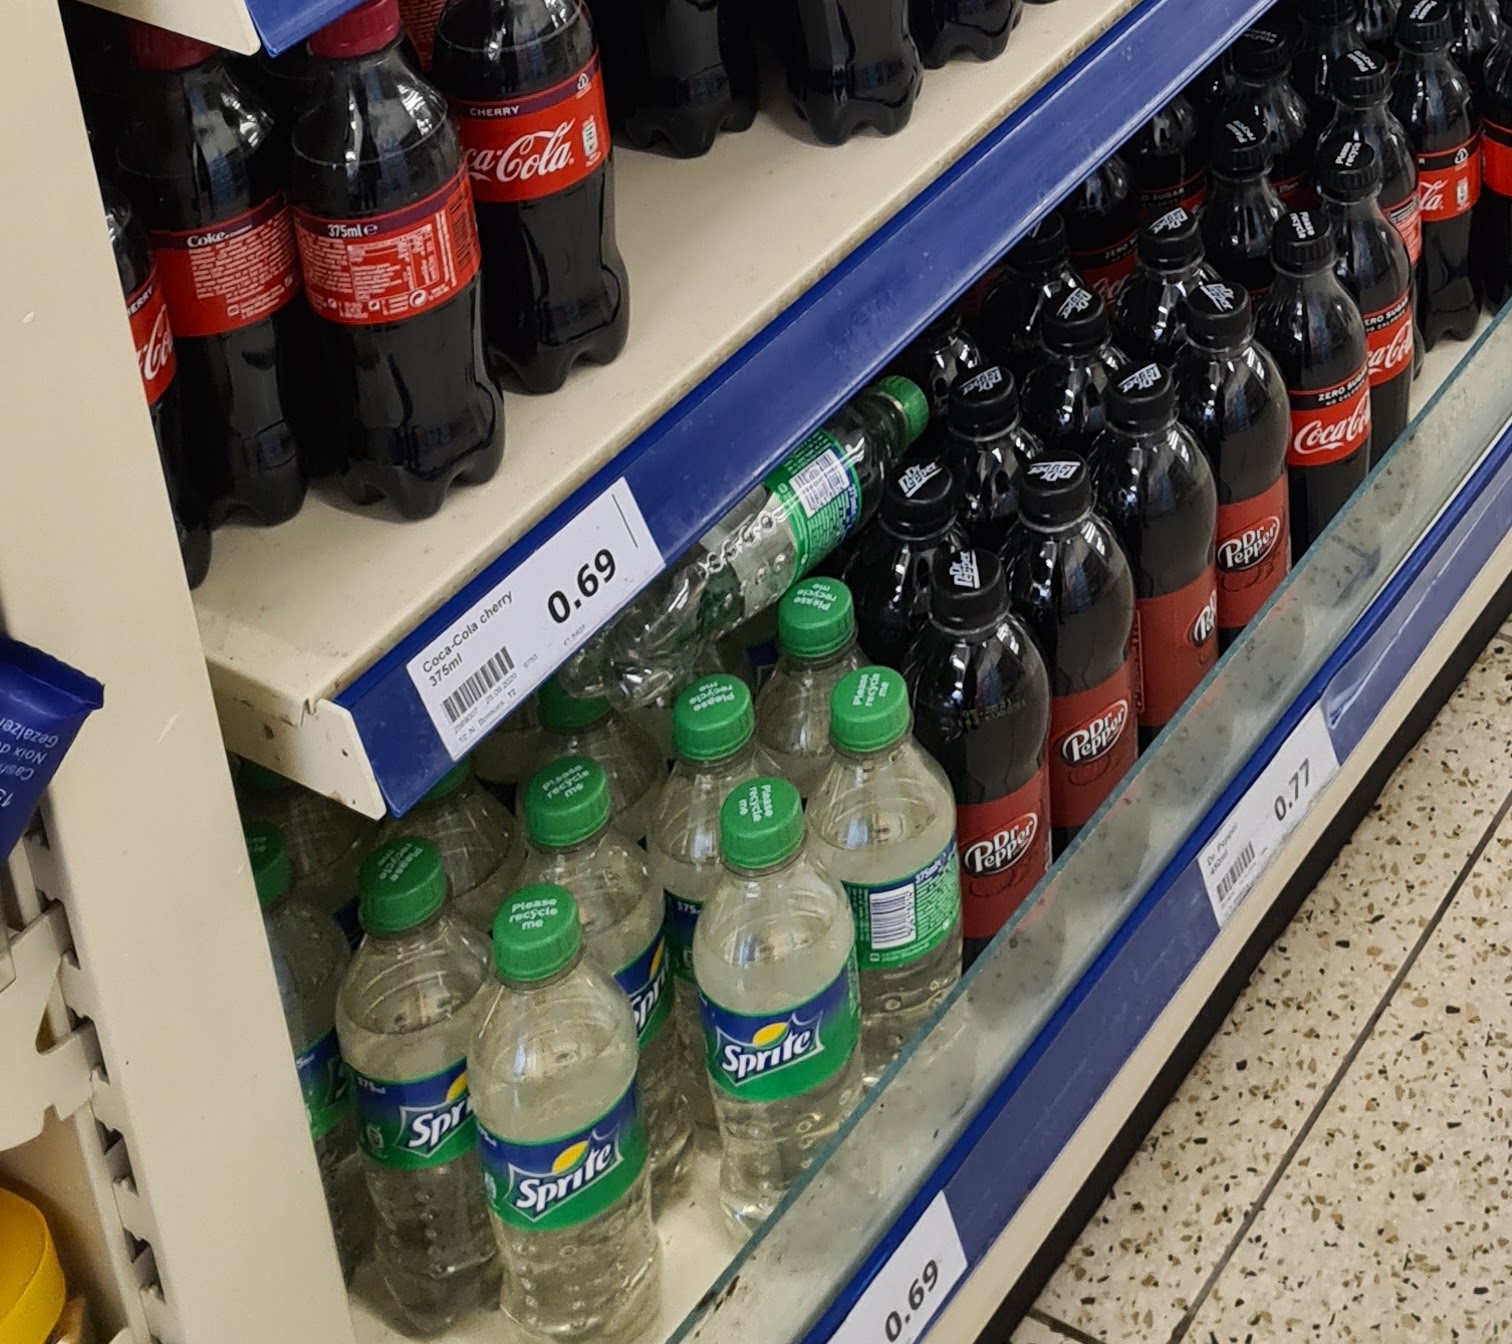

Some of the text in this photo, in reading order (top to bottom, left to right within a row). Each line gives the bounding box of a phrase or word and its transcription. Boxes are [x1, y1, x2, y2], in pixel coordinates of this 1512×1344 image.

[469, 104, 520, 119] CHERRY
[327, 223, 363, 239] 375ml
[1317, 387, 1341, 402] ZERO
[1220, 523, 1277, 569] Pepper
[1240, 526, 1265, 546] Dr
[547, 548, 616, 625] 0.69
[422, 590, 514, 675] Coca-Cola cherry
[427, 652, 464, 688] 375ml
[852, 674, 869, 706] Please
[1065, 707, 1124, 762] Pepper
[1089, 713, 1113, 733] Dr
[18, 747, 47, 766] Noix
[541, 764, 583, 792] Please
[545, 769, 591, 800] recycle
[564, 782, 585, 798] me
[1273, 757, 1311, 822] 0.77
[738, 799, 748, 816] me
[748, 786, 762, 823] recycle
[760, 784, 774, 818] Please
[968, 817, 1034, 873] Pepper
[993, 824, 1019, 845] Dr
[508, 908, 559, 924] recycle
[511, 898, 558, 914] Please
[521, 920, 544, 931] me
[721, 1029, 811, 1079] Sprite
[515, 1143, 612, 1212] Sprite
[884, 1260, 940, 1344] 0.69
